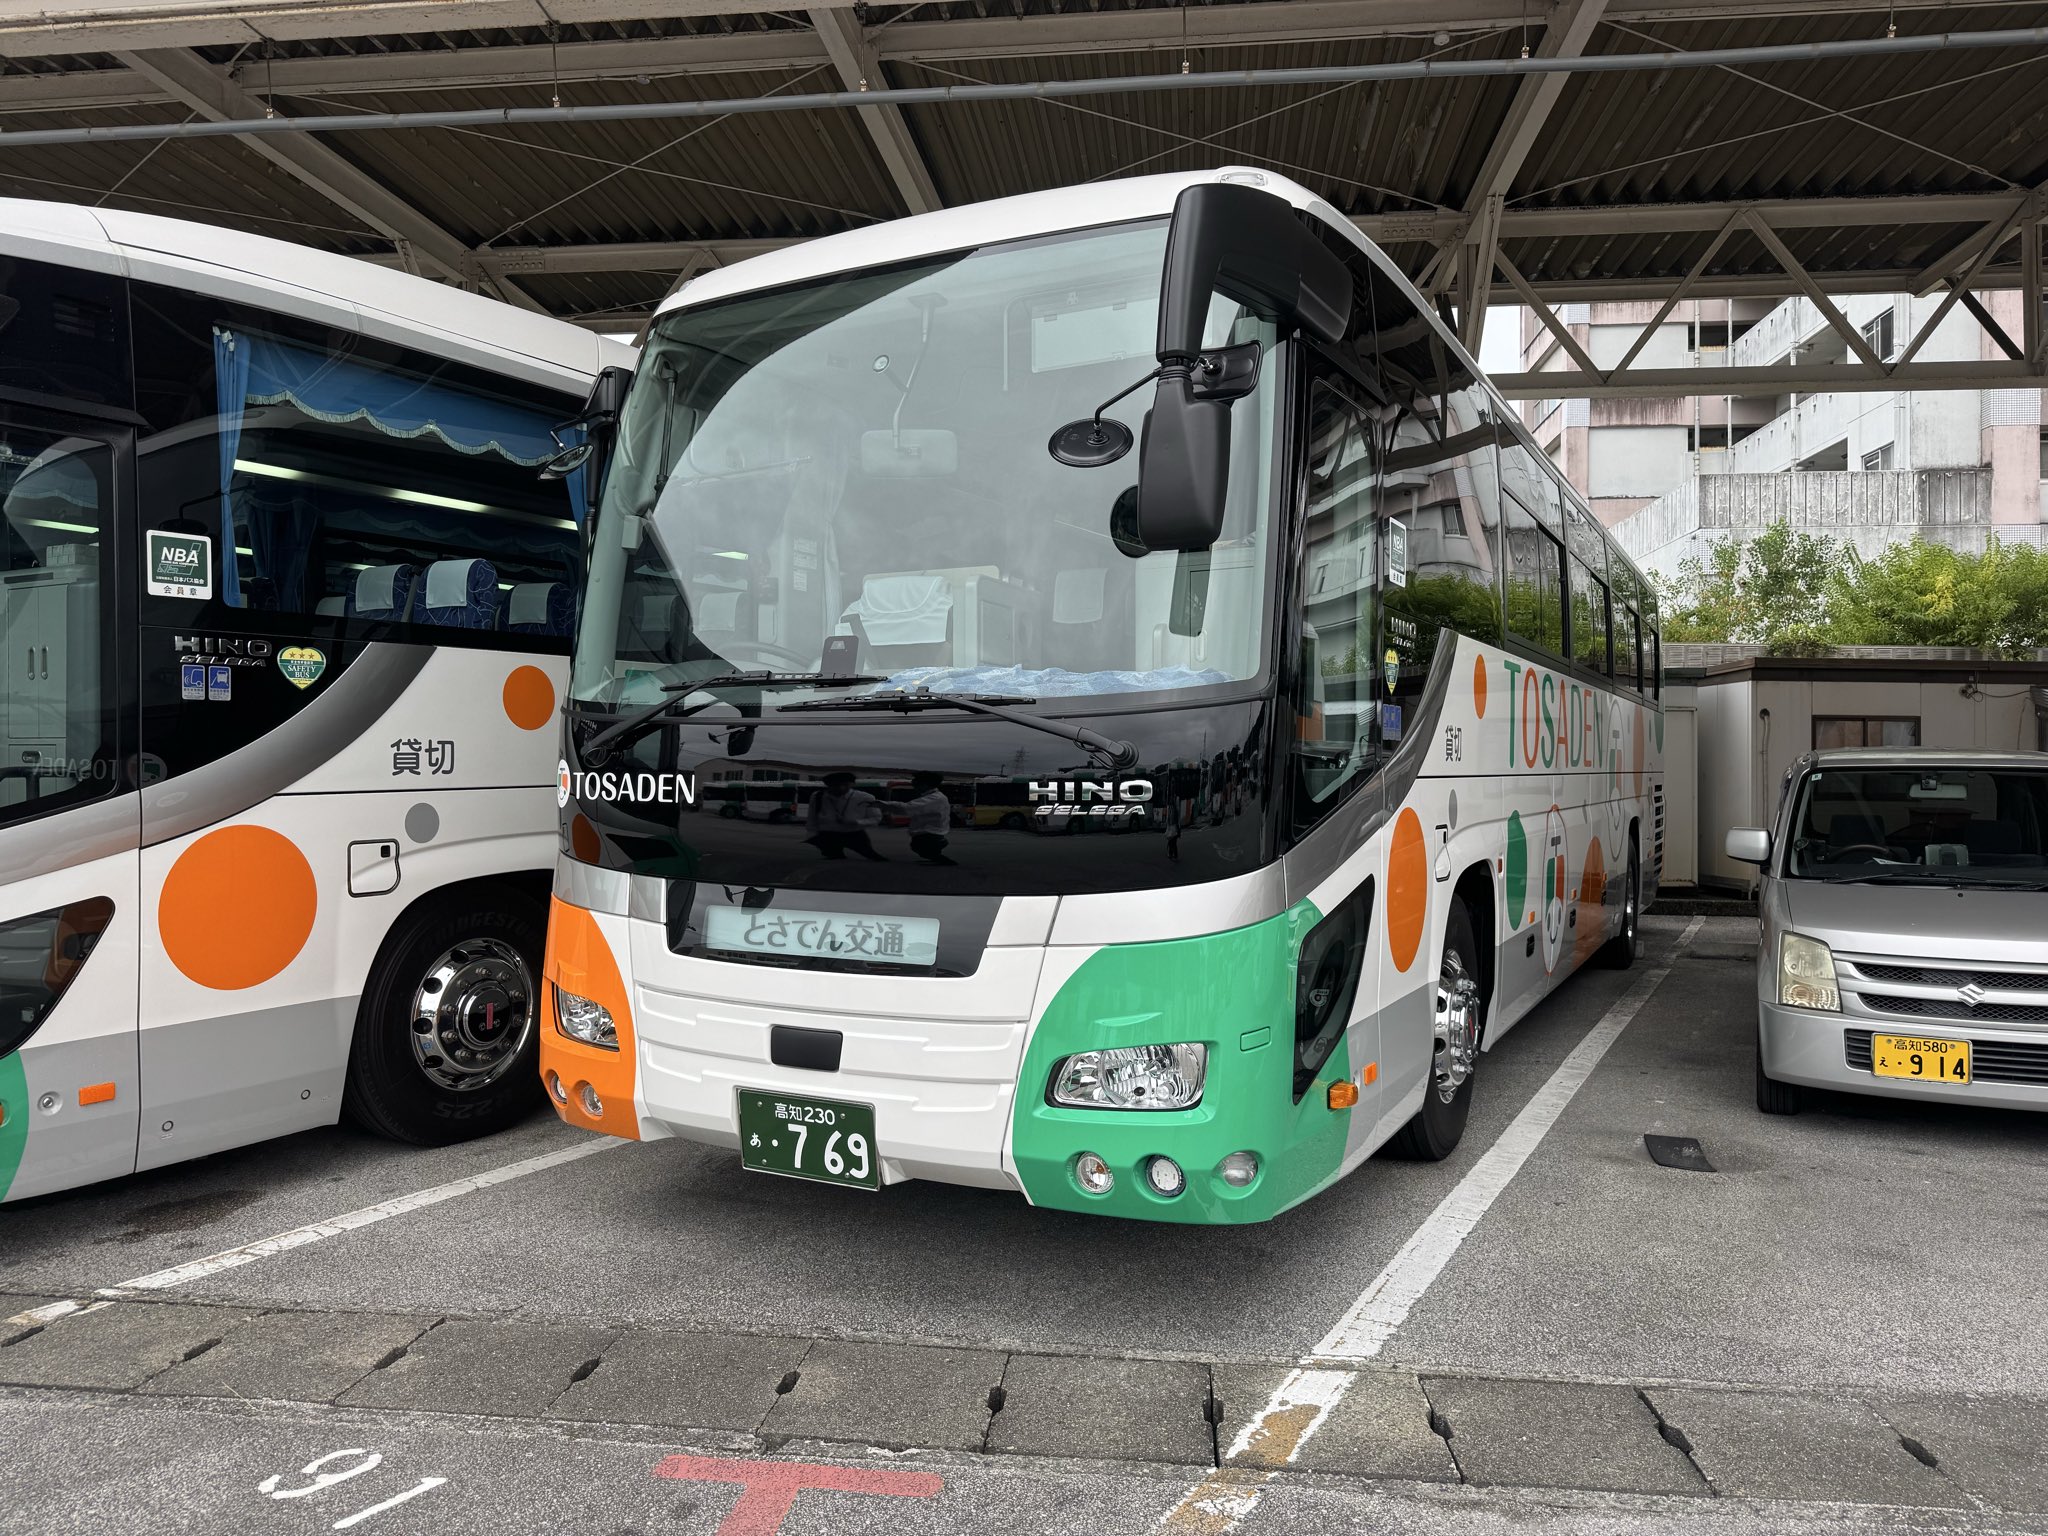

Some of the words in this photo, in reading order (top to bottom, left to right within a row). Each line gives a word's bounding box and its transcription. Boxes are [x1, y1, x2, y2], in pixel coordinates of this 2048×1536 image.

[161, 547, 199, 563] NBA
[1391, 617, 1417, 639] HINO
[174, 635, 272, 656] HINO
[288, 665, 316, 673] SAFETY
[1504, 659, 1603, 769] TOSADEN
[1445, 725, 1462, 762] 貸切
[390, 738, 455, 776] 貸切
[573, 771, 695, 805] TOSADEN
[1028, 780, 1153, 802] HINO
[743, 914, 905, 957] とさでん交通
[1894, 1039, 1948, 1053] 高知580
[1879, 1057, 1888, 1067] え
[774, 1102, 836, 1125] 高知230
[750, 1132, 761, 1148] あ
